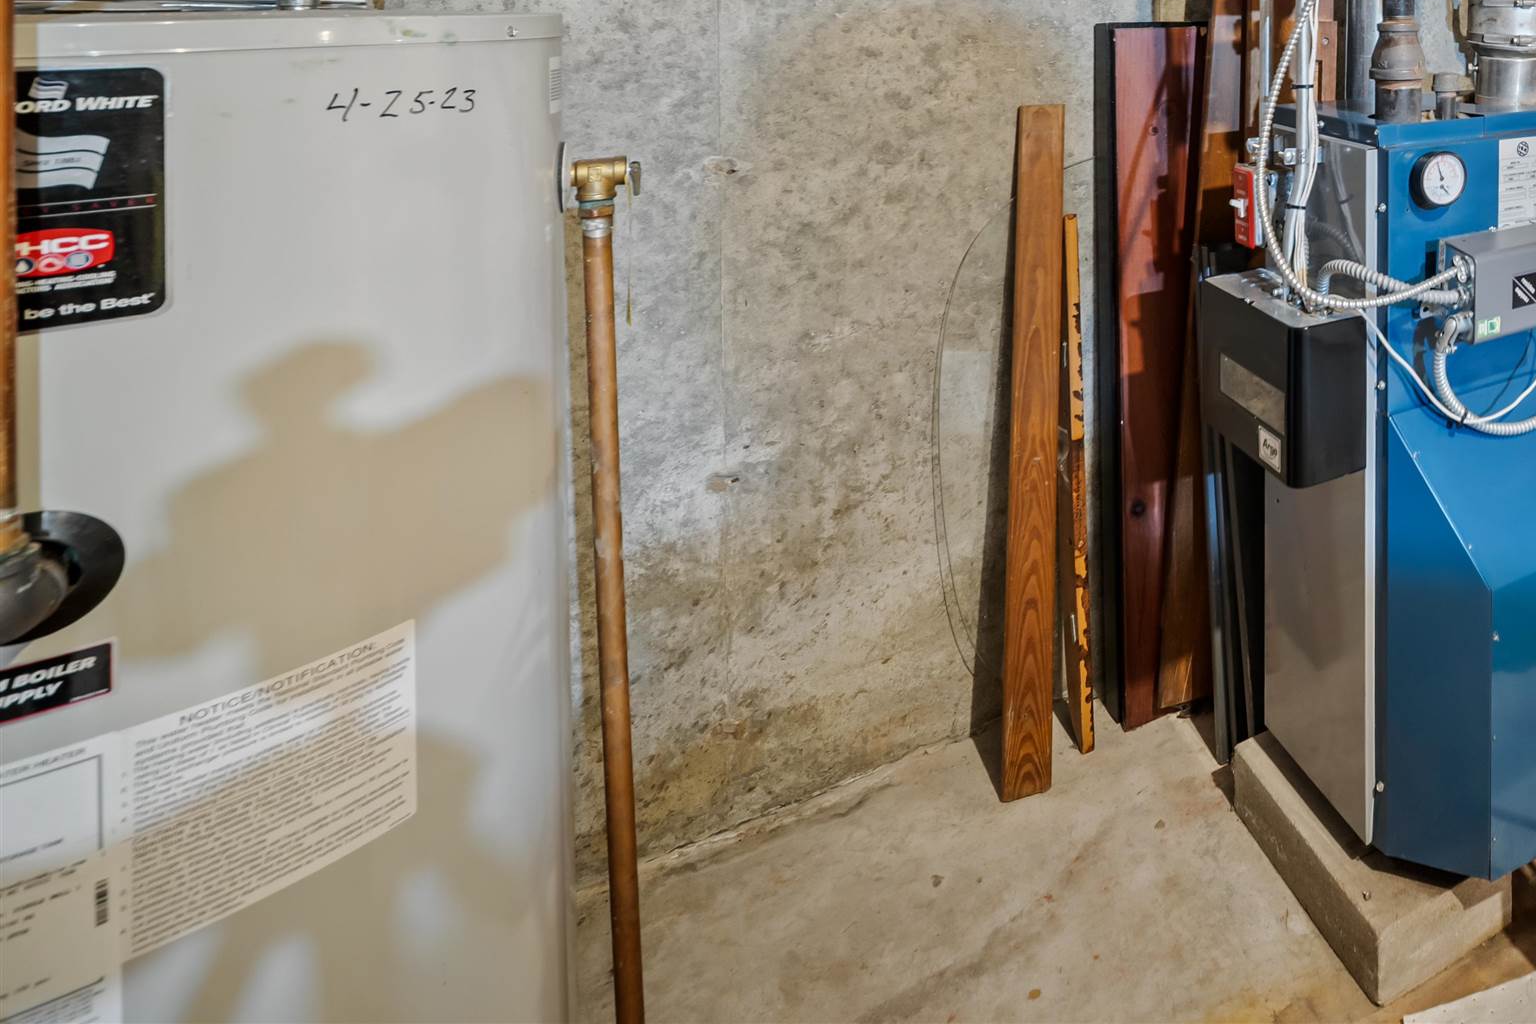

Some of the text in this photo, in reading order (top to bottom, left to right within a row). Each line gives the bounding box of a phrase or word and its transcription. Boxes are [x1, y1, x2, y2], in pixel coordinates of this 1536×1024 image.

[15, 95, 155, 114] ORD WHITE
[24, 293, 153, 320] be the Best
[1262, 438, 1278, 457] Argo
[11, 656, 98, 689] BOILER
